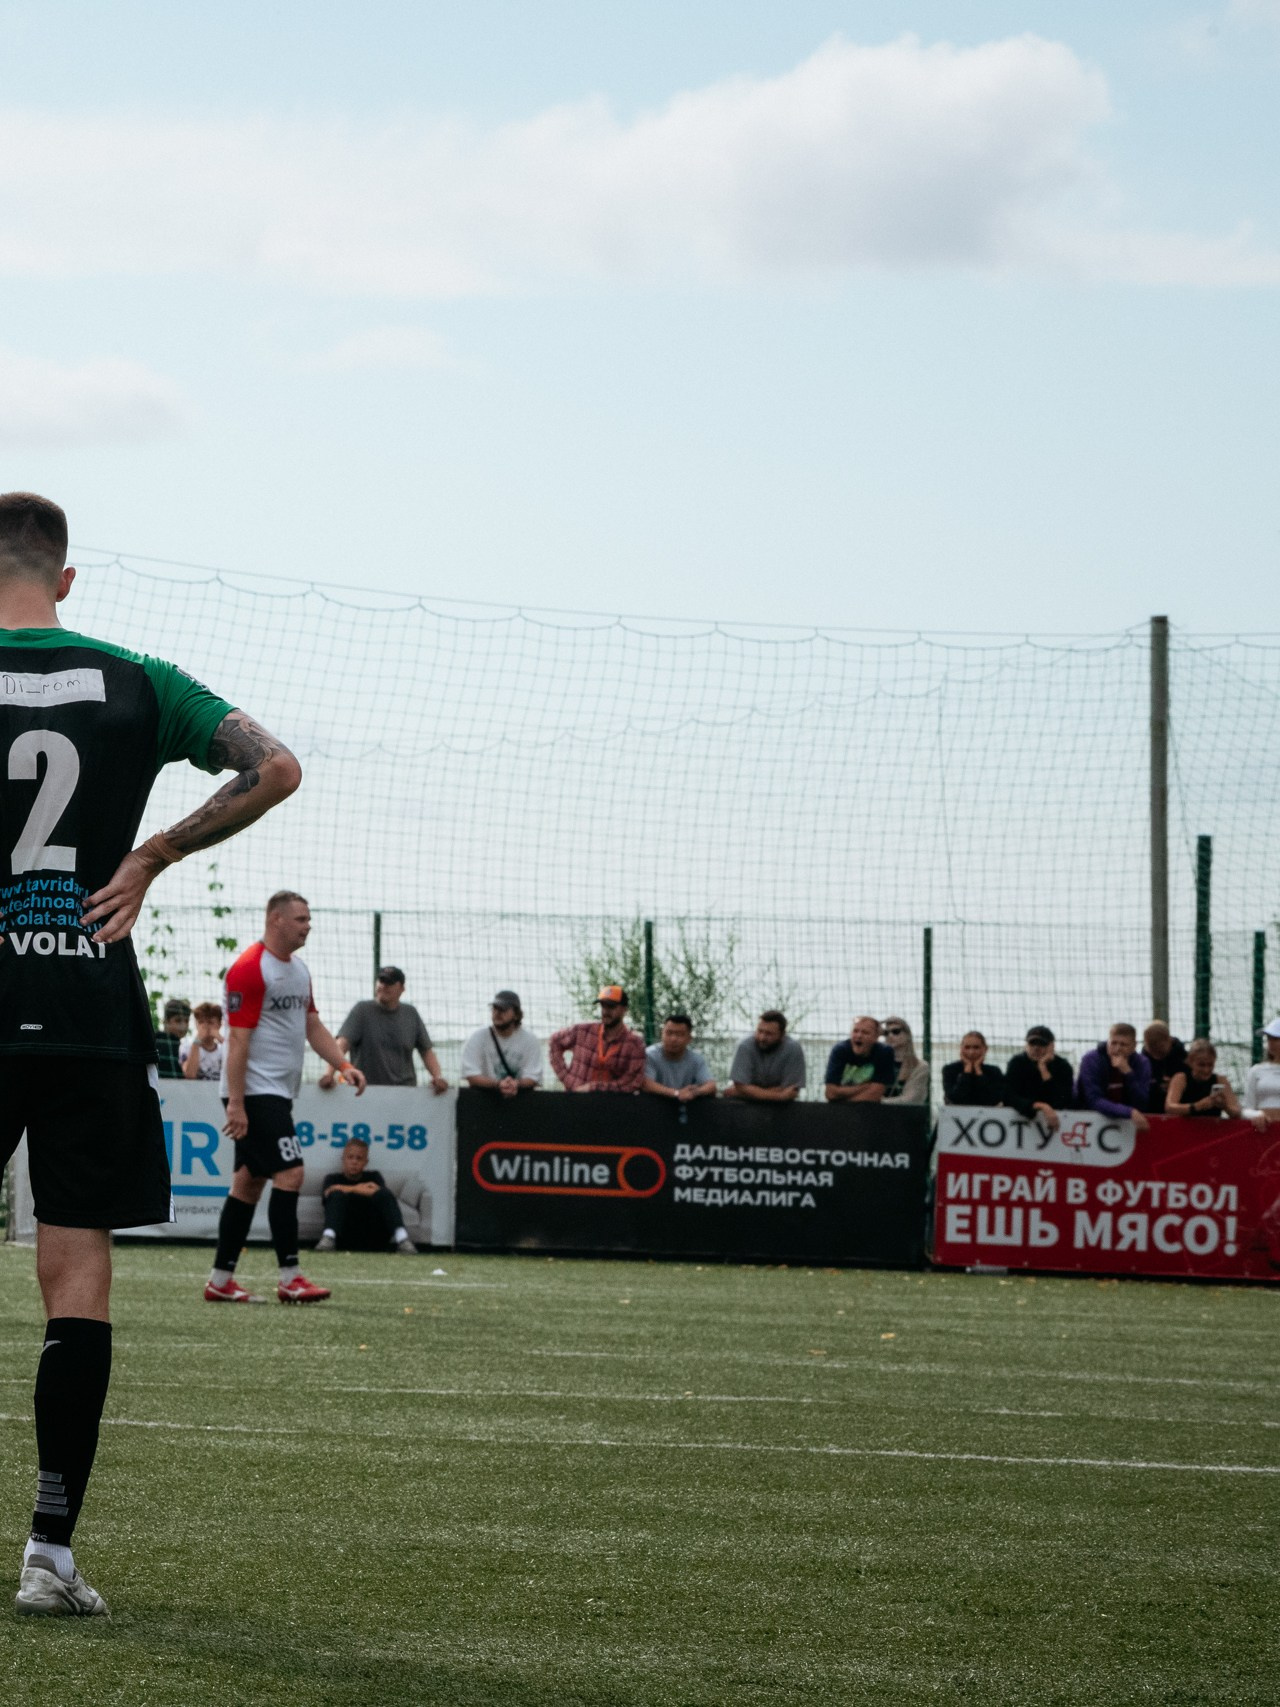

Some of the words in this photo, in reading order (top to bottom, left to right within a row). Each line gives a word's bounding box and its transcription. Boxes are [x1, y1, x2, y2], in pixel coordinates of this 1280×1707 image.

[8, 730, 81, 876] 2
[490, 1153, 611, 1185] Winline
[673, 1143, 910, 1169] ДАЛЬНЕВОСТОЧНАЯ
[673, 1165, 834, 1188] ФУТБОЛЬНАЯ
[946, 1169, 1057, 1203] ИГРАЙ
[1066, 1178, 1089, 1204] В
[1095, 1179, 1238, 1212] ФУТБОЛ
[673, 1186, 816, 1208] МЕДИАЛИГА
[945, 1204, 1060, 1247] ЕШЬ
[1073, 1210, 1238, 1257] МЯСО!
